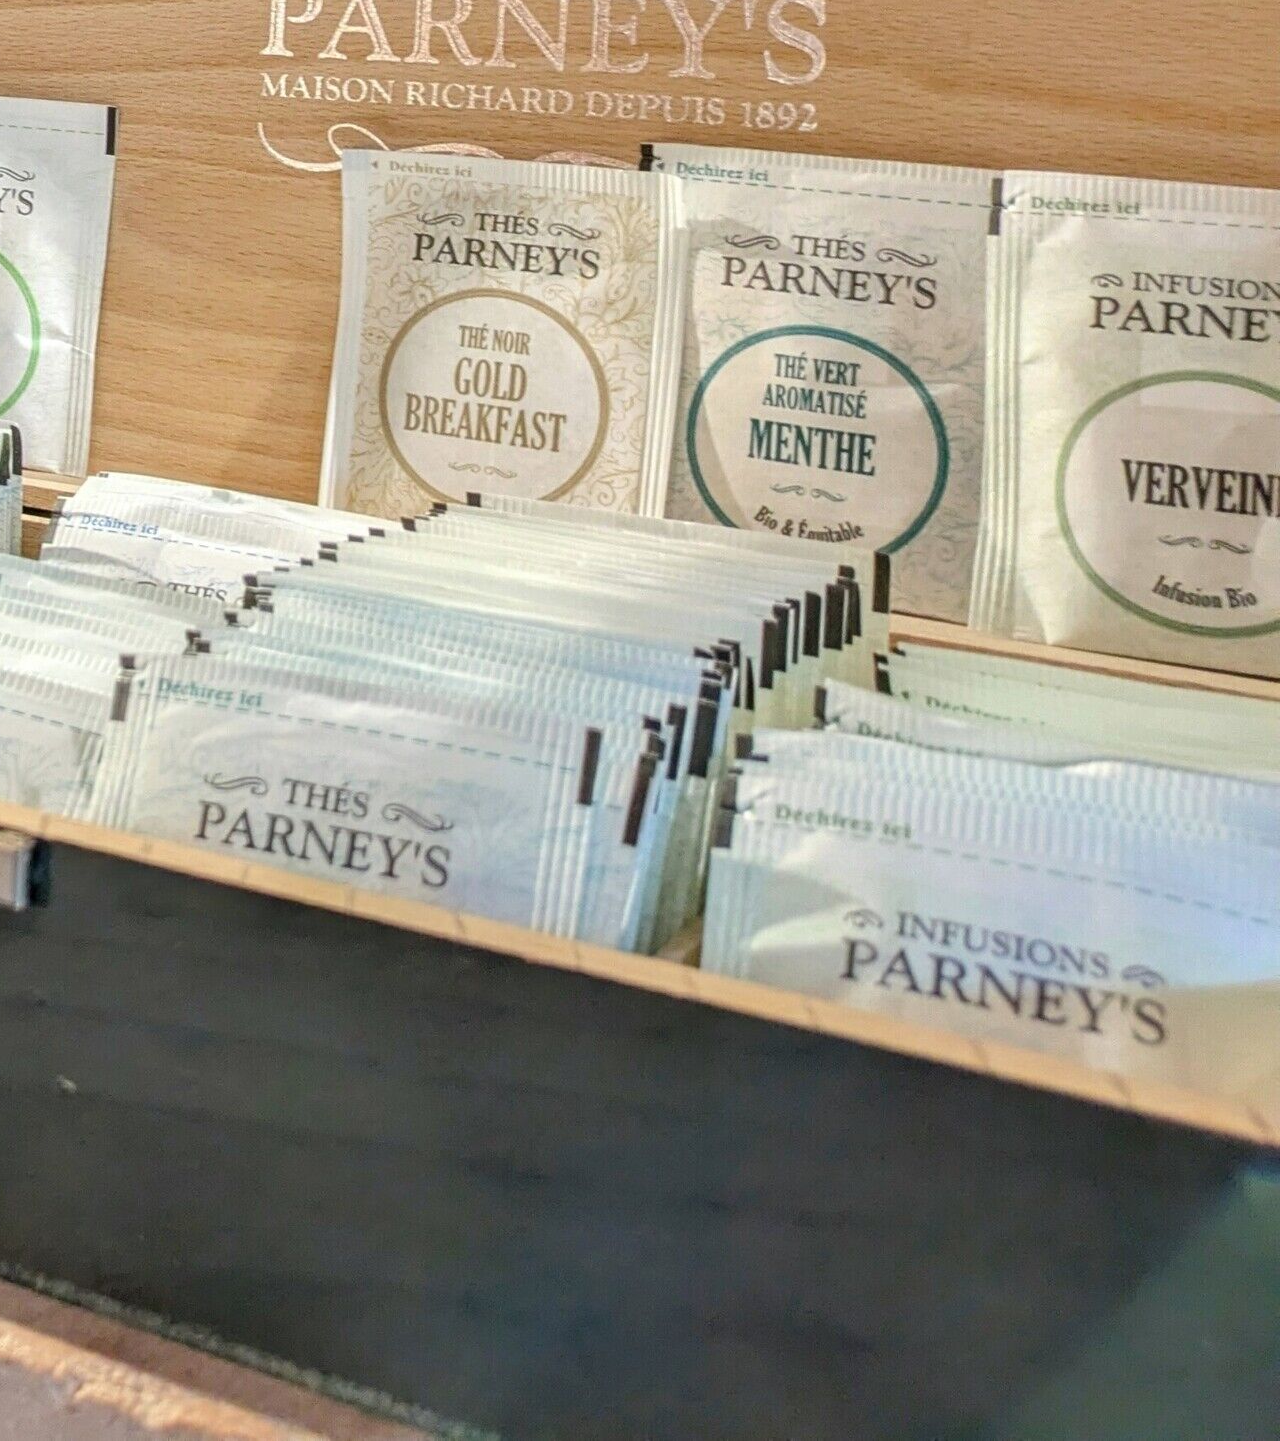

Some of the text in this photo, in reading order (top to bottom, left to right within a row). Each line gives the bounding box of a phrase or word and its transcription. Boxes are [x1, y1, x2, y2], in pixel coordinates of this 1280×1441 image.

[261, 72, 818, 133] MAISON RICHARD DEPUIS 1892
[455, 166, 472, 177] ici
[749, 168, 768, 182] ici
[475, 211, 539, 236] THÉS
[413, 233, 601, 279] PARNEY'S
[791, 231, 866, 261] THÉS
[721, 256, 938, 310] PARNEY'S
[459, 323, 530, 356] THÉ NOIR
[1089, 295, 1280, 344] PARNE
[454, 356, 528, 403] GOLD
[774, 351, 860, 387] THÉ VERT
[403, 392, 567, 453] BREAKFAST
[761, 382, 867, 420] AROMATISÉ
[748, 418, 876, 477] MENTHE
[1121, 459, 1280, 518] VERVEIN
[142, 525, 159, 535] ici
[754, 505, 778, 530] Bio
[781, 519, 793, 536] &
[1152, 575, 1257, 608] Infusion Bio
[240, 689, 263, 706] ici
[282, 775, 369, 819] THÉS
[195, 800, 451, 889] PARNEY'S
[896, 909, 1110, 980] INFUSIONS
[841, 938, 1168, 1047] PARNEY'S
